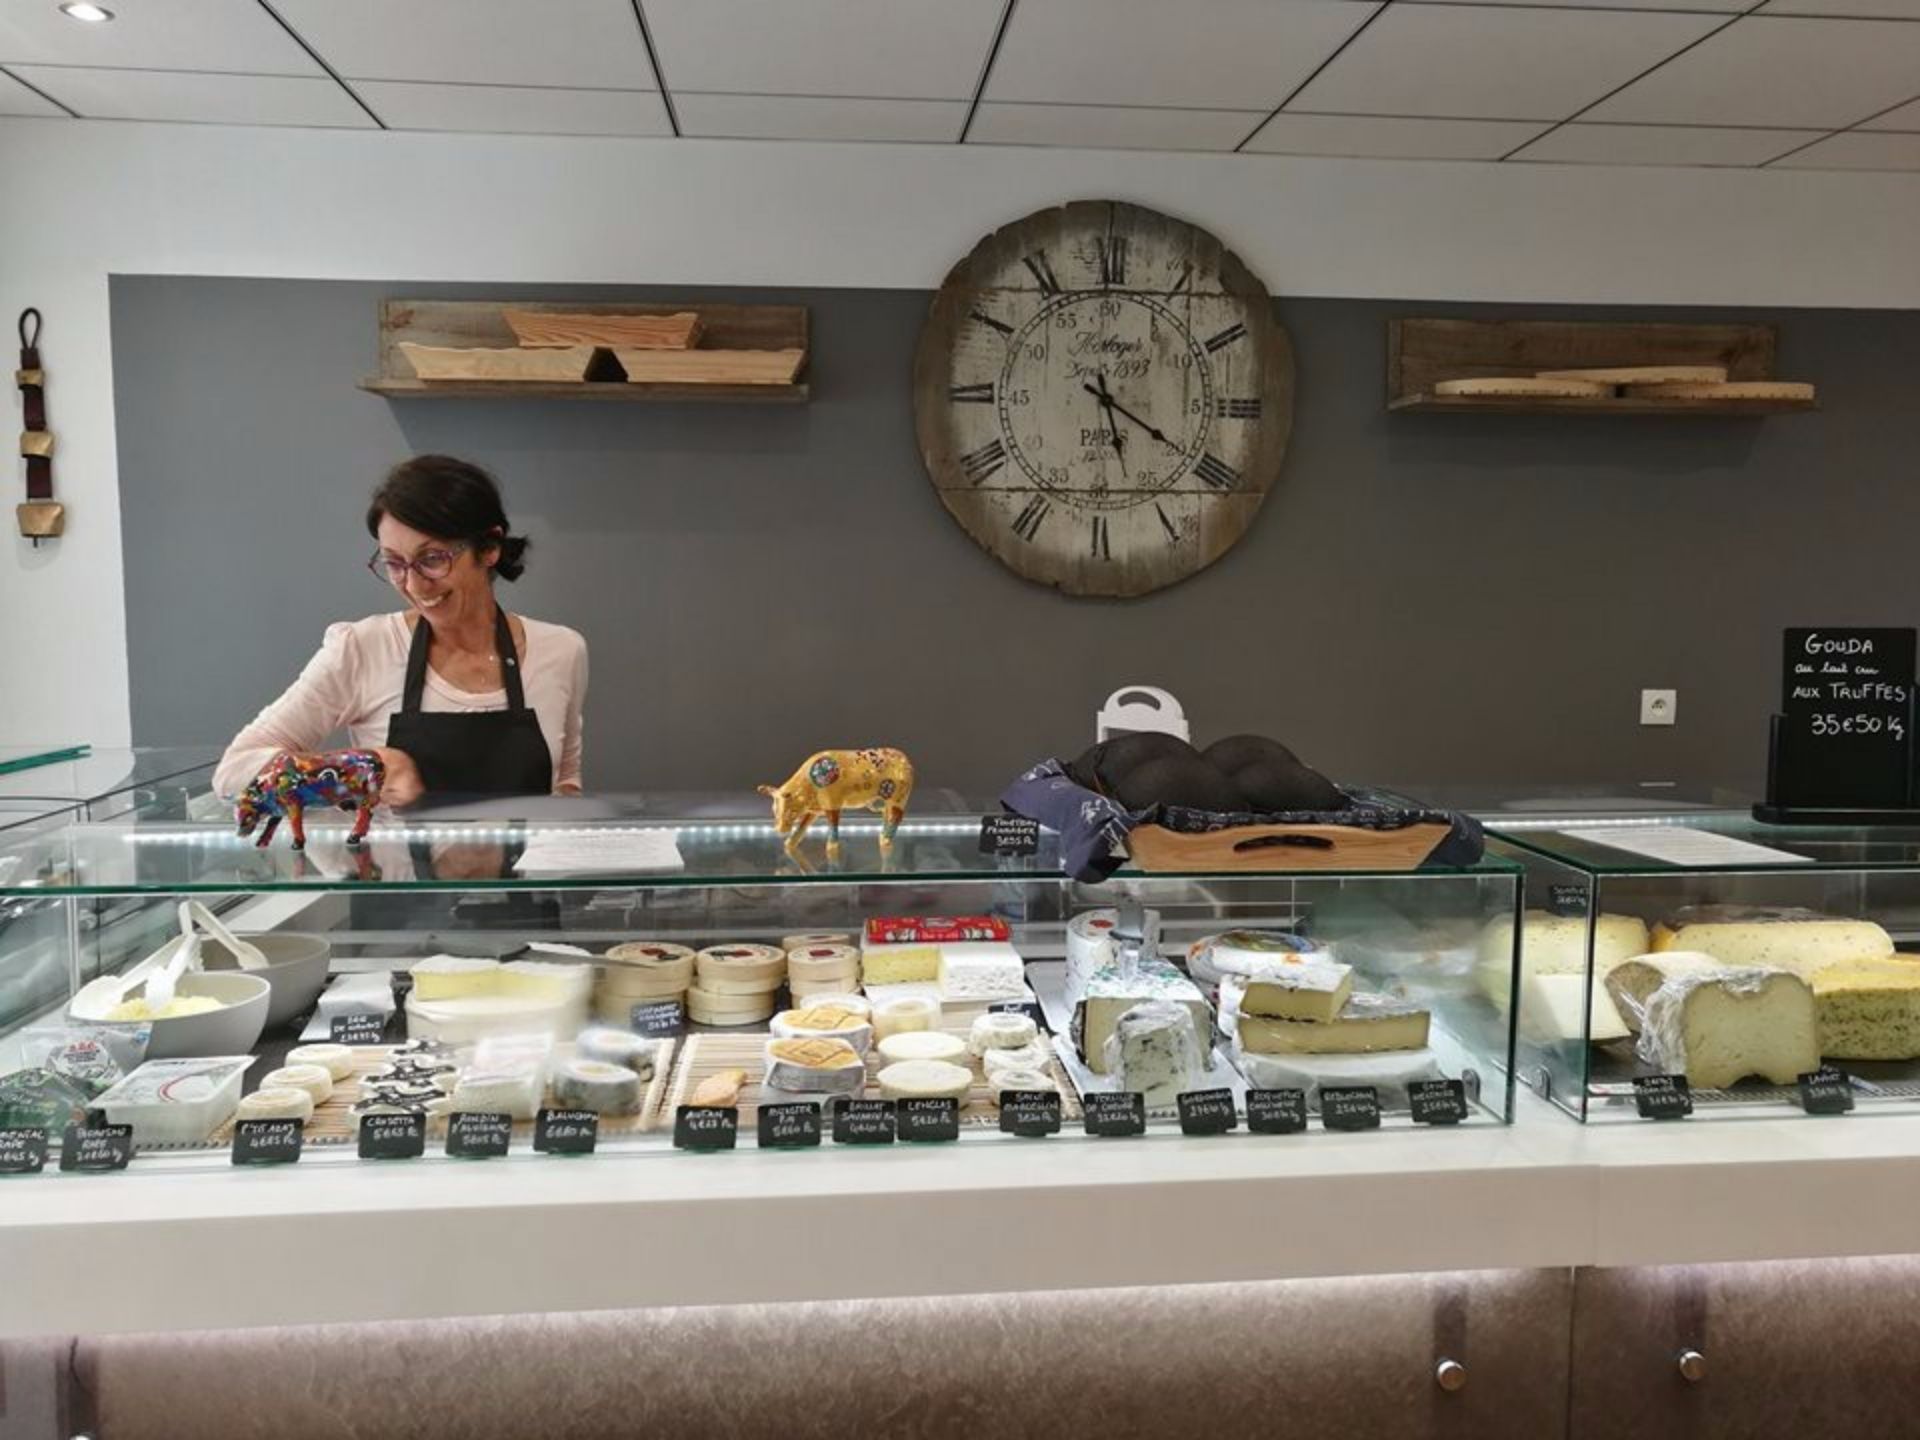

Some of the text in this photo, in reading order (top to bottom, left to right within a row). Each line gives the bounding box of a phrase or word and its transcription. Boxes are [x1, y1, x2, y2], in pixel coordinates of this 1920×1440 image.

[1804, 633, 1874, 655] GOUDA
[1795, 663, 1814, 673] au
[1792, 681, 1906, 702] AUX TRUFFES
